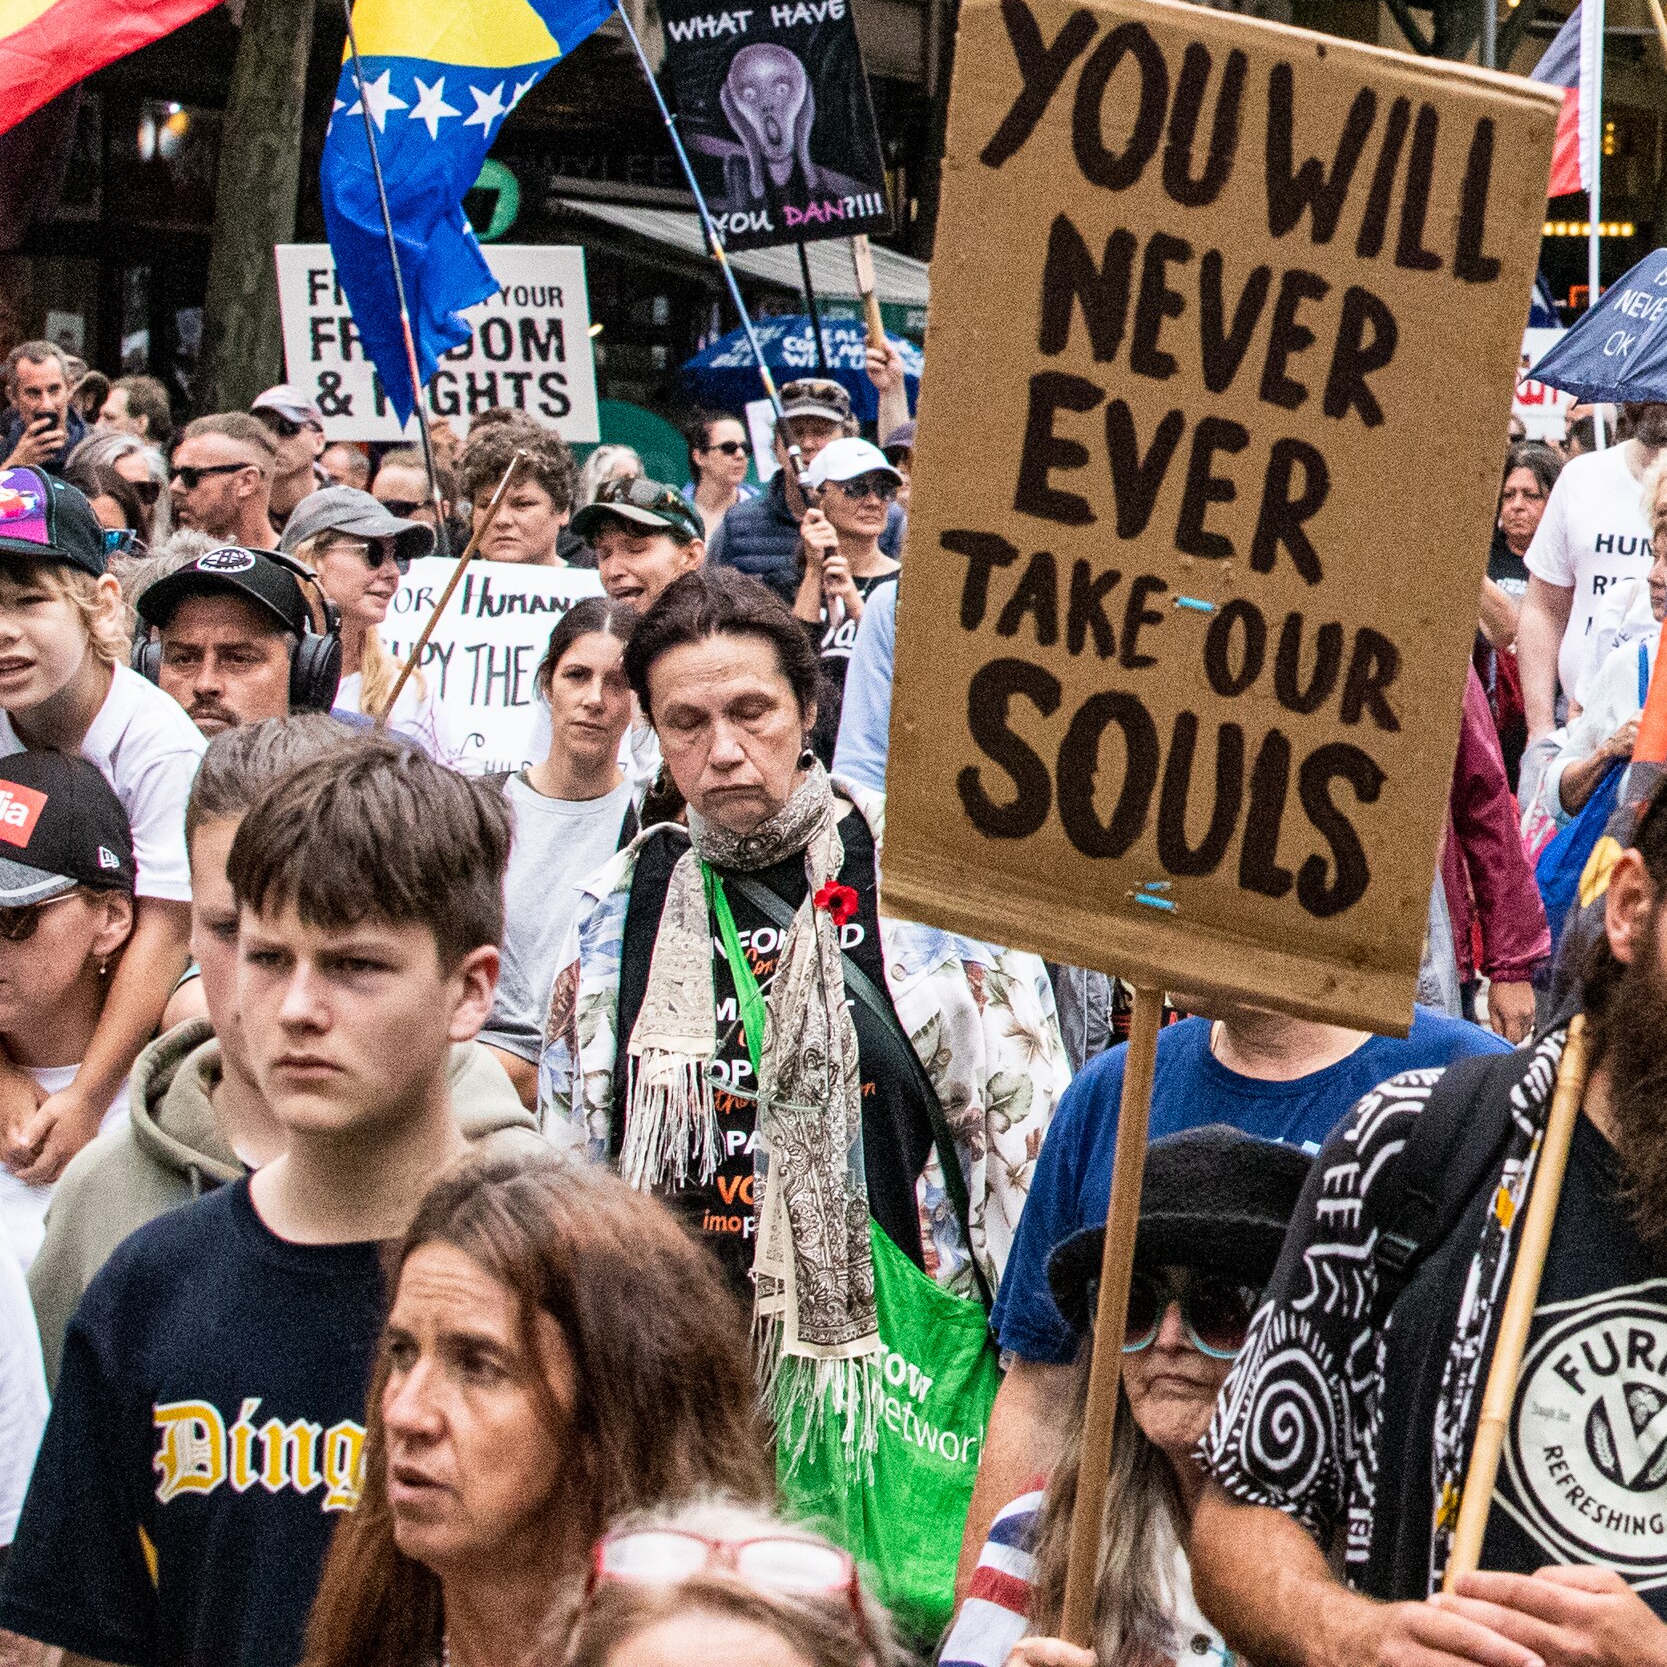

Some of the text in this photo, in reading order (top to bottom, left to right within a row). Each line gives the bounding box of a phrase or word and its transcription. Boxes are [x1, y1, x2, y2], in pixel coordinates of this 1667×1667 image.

[667, 10, 754, 43] WHAT
[1267, 62, 1501, 283] WILL
[711, 210, 775, 246] YOU
[498, 285, 565, 309] YOUR
[1039, 213, 1399, 429] NEVER
[1603, 330, 1636, 357] OK
[315, 370, 354, 418] &
[1013, 371, 1331, 586] EVER
[464, 642, 535, 708] THE
[940, 529, 1401, 732] TAKE OUR
[956, 657, 1388, 918] SOULS
[152, 1397, 369, 1513] Ding
[1544, 1444, 1664, 1536] REFRESHING
